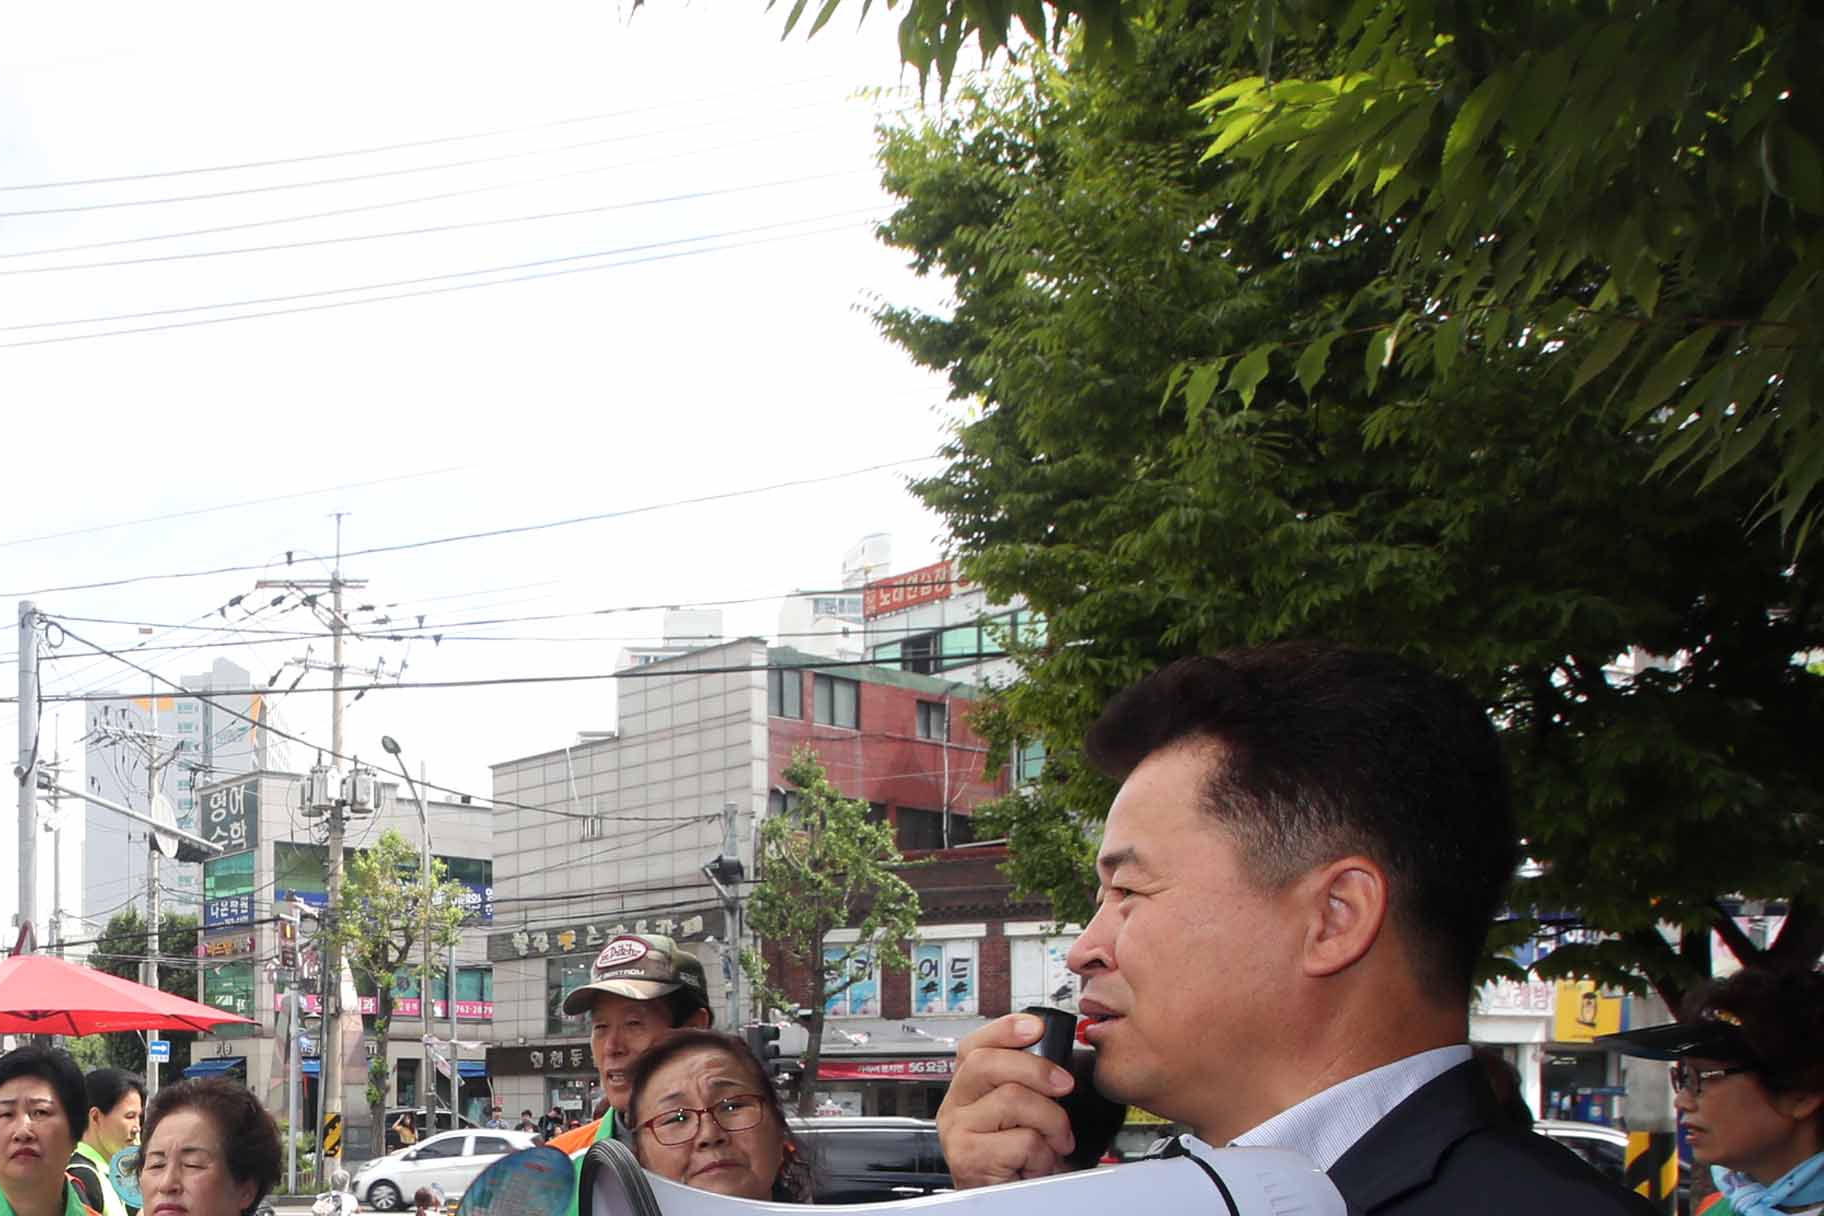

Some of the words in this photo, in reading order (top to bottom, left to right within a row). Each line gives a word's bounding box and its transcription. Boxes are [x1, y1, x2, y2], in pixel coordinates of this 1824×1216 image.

[210, 784, 246, 823] 영어
[210, 818, 247, 850] 수학
[210, 896, 249, 919] 다온학원
[530, 1049, 597, 1069] 인천동
